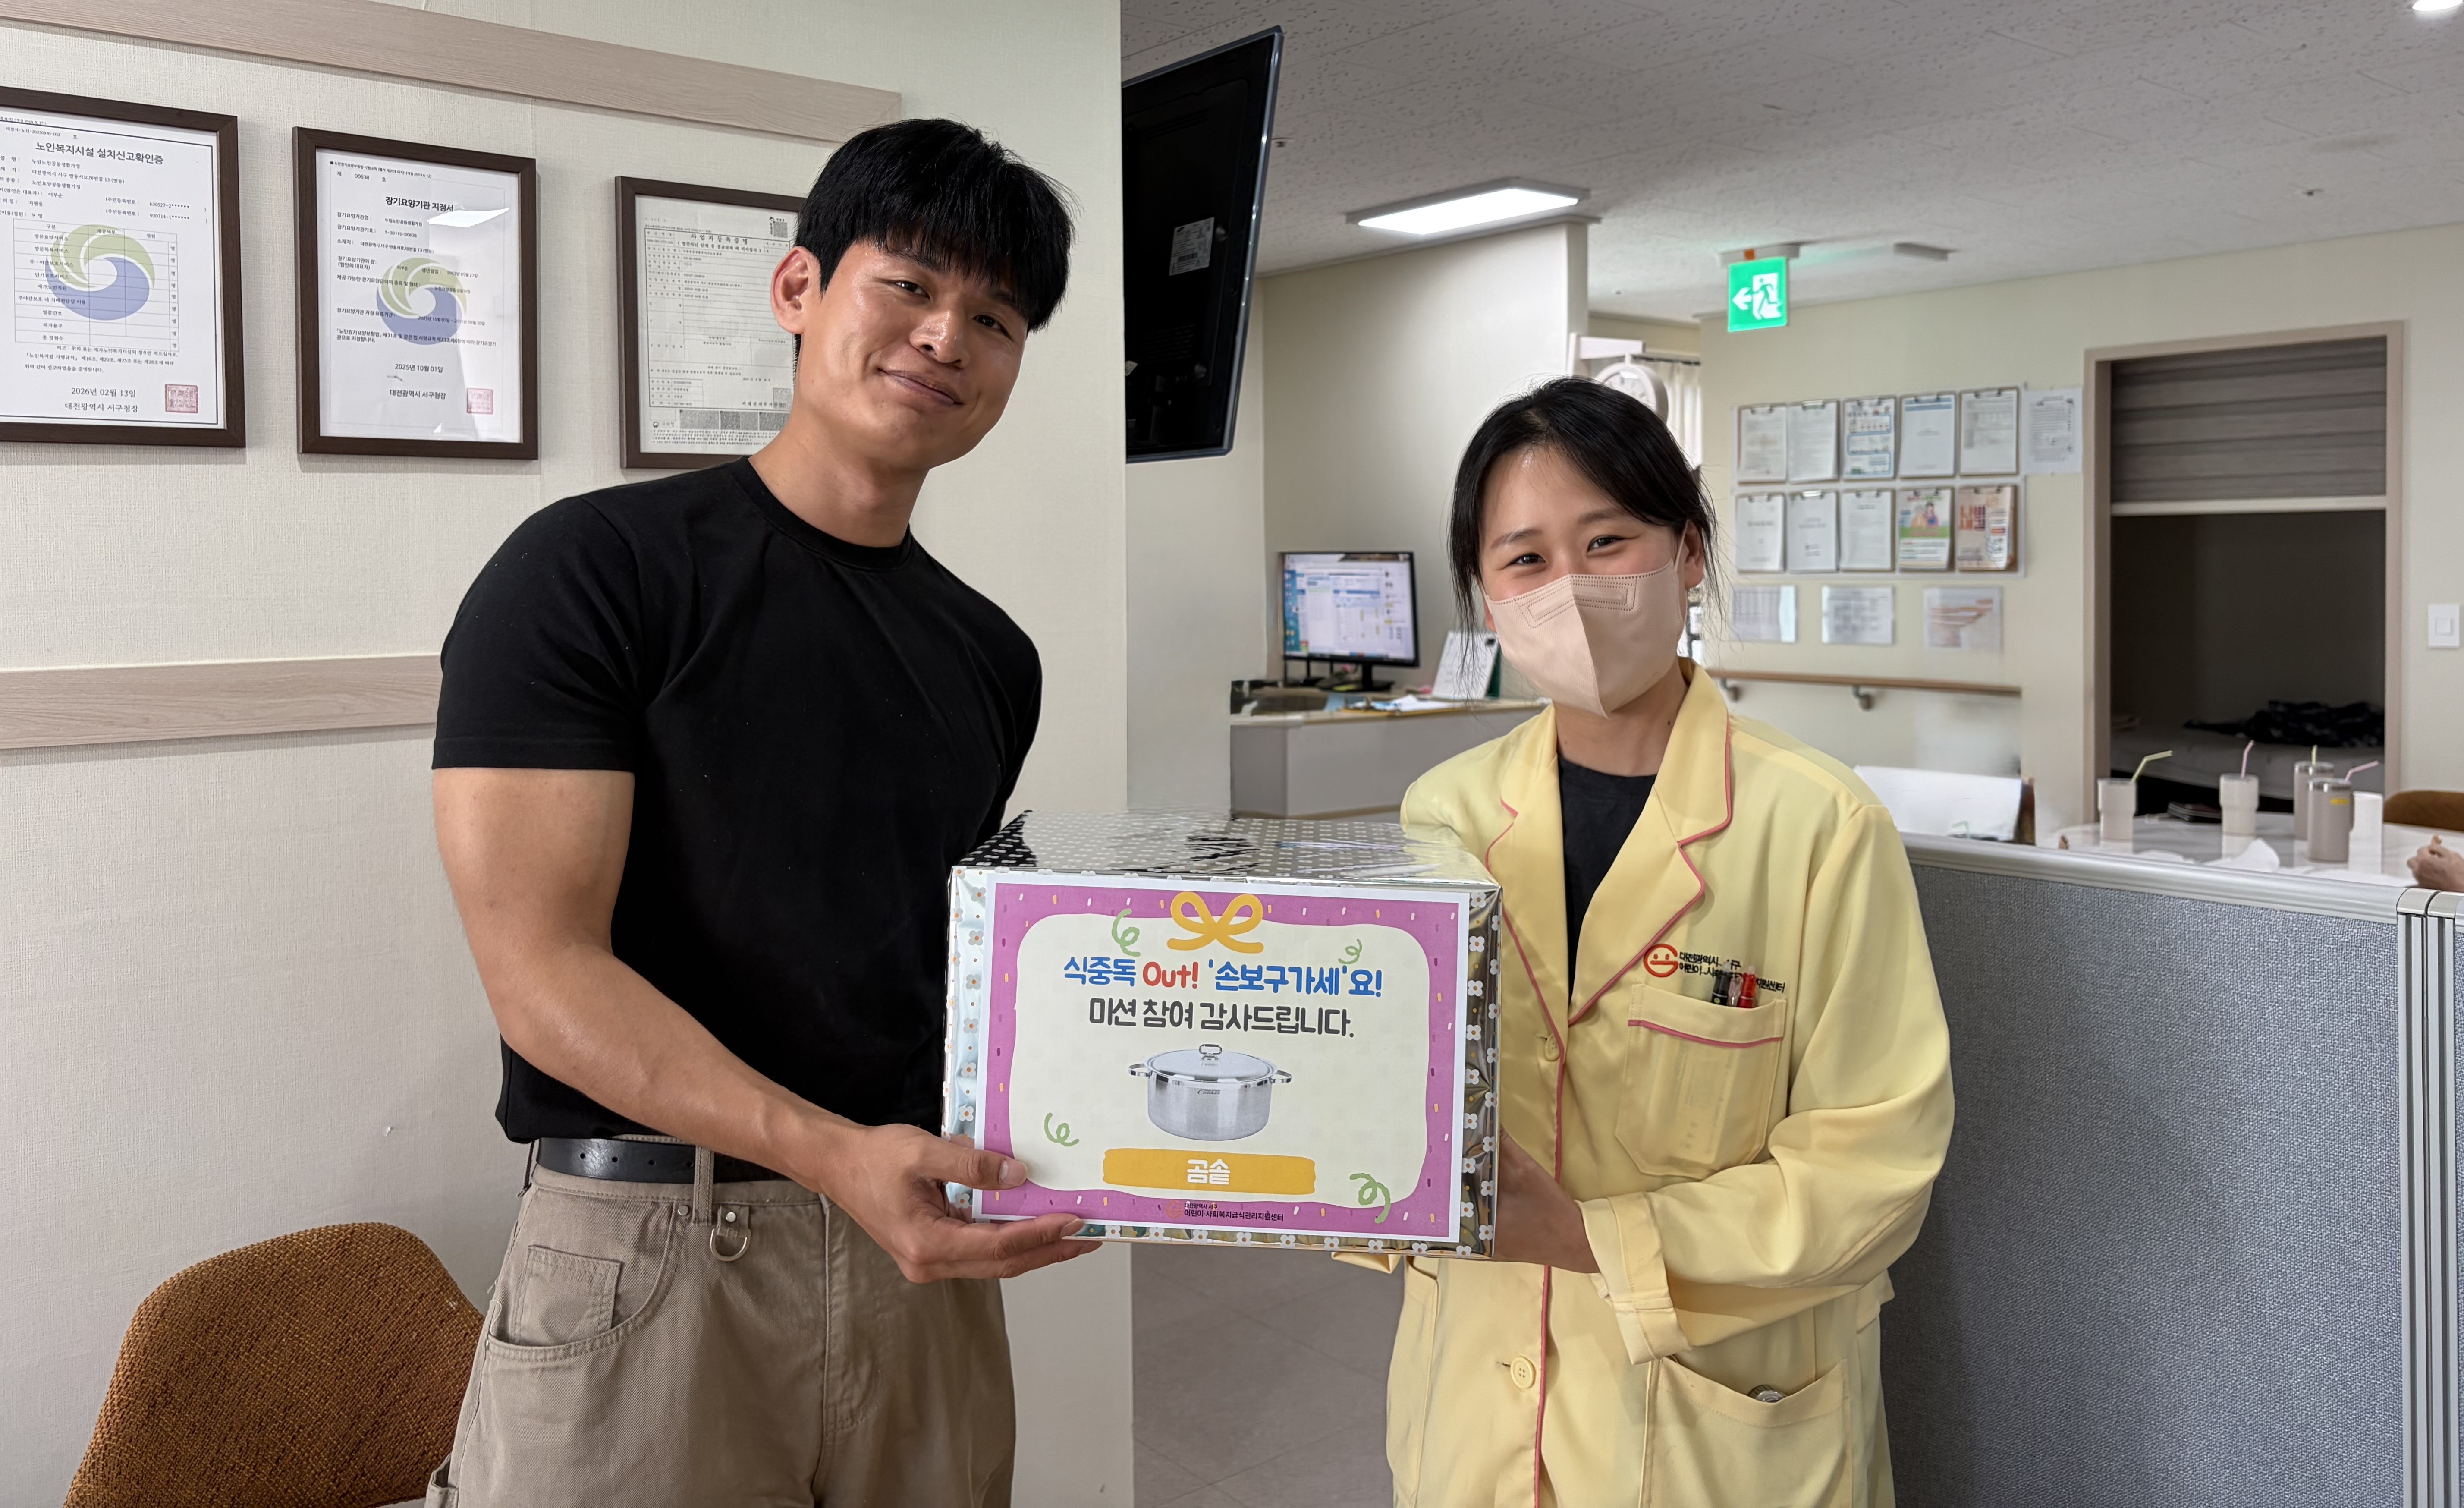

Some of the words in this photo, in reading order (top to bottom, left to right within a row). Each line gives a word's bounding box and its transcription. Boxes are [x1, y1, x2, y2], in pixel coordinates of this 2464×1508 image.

[35, 142, 94, 157] 노인복지시설
[97, 149, 164, 165] 설치신고확인증
[385, 196, 431, 210] 장기요양기관
[431, 201, 454, 212] 지정서
[395, 363, 415, 371] 2025년
[417, 364, 429, 372] 10월
[431, 365, 443, 374] 01일
[71, 387, 97, 396] 2026년
[120, 390, 136, 398] 13일
[389, 389, 421, 399] 대전광역시
[422, 390, 446, 400] 서구청장
[65, 403, 104, 411] 대전광역시
[107, 404, 138, 413] 서구청장
[1063, 956, 1136, 987] 식중독
[1142, 961, 1199, 989] Out!
[1208, 959, 1382, 997] '손보구가세'요!
[1089, 998, 1137, 1026] 미션
[1143, 999, 1194, 1029] 참여
[1200, 1002, 1354, 1038] 감사드립니다.
[1186, 1158, 1231, 1185] 곰솥
[1184, 1209, 1283, 1221] 어린이·사회복지급식관리지원센터
